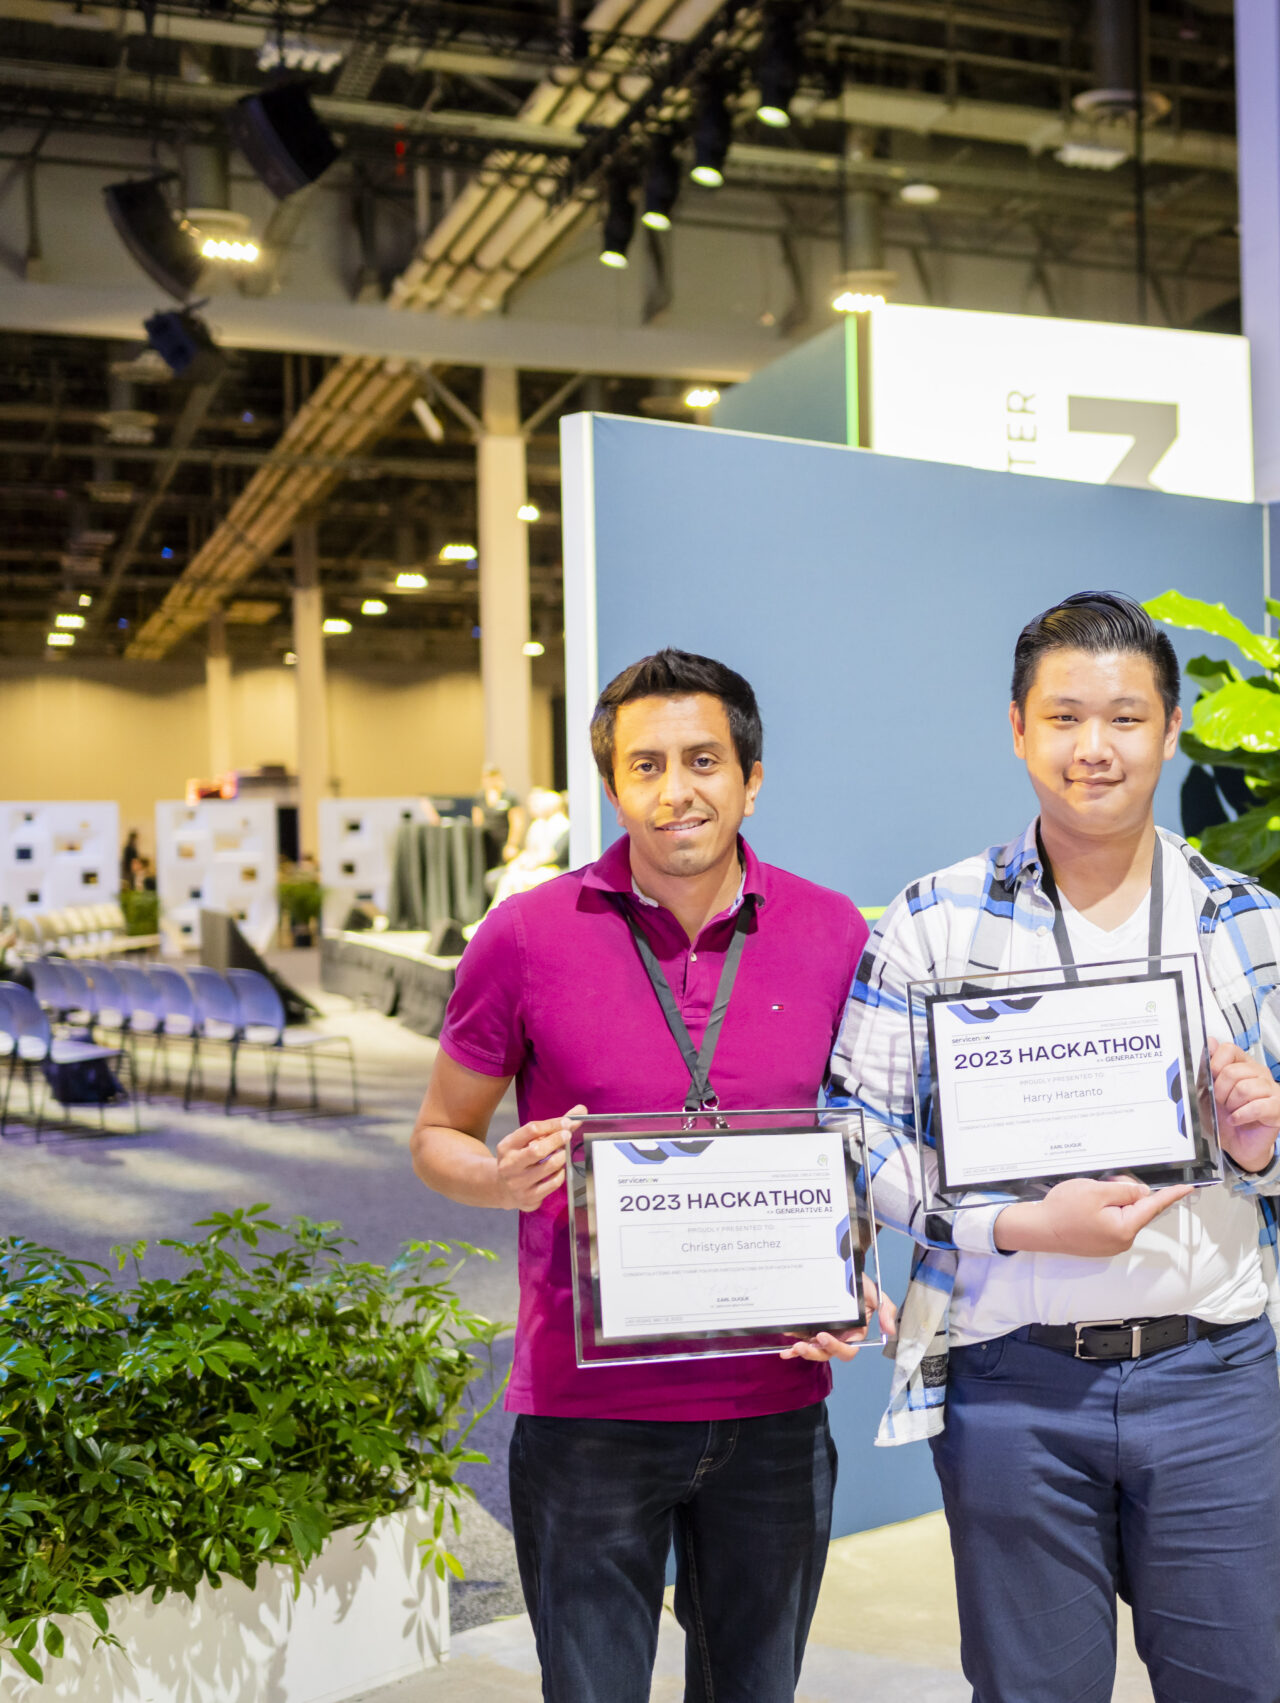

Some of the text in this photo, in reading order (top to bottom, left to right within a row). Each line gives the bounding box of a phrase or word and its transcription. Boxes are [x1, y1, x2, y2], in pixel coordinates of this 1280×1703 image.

[952, 1034, 990, 1043] servicenow
[954, 1034, 1161, 1070] 2023 HACKATHON
[1105, 1053, 1152, 1062] GENERATIVE
[1023, 1087, 1103, 1105] Harry Hartanto
[617, 1176, 659, 1185] servicenow
[620, 1189, 831, 1212] 2023 HACKATHON
[775, 1207, 823, 1215] GENERATIVE
[681, 1239, 782, 1254] Christyan Sanchez
